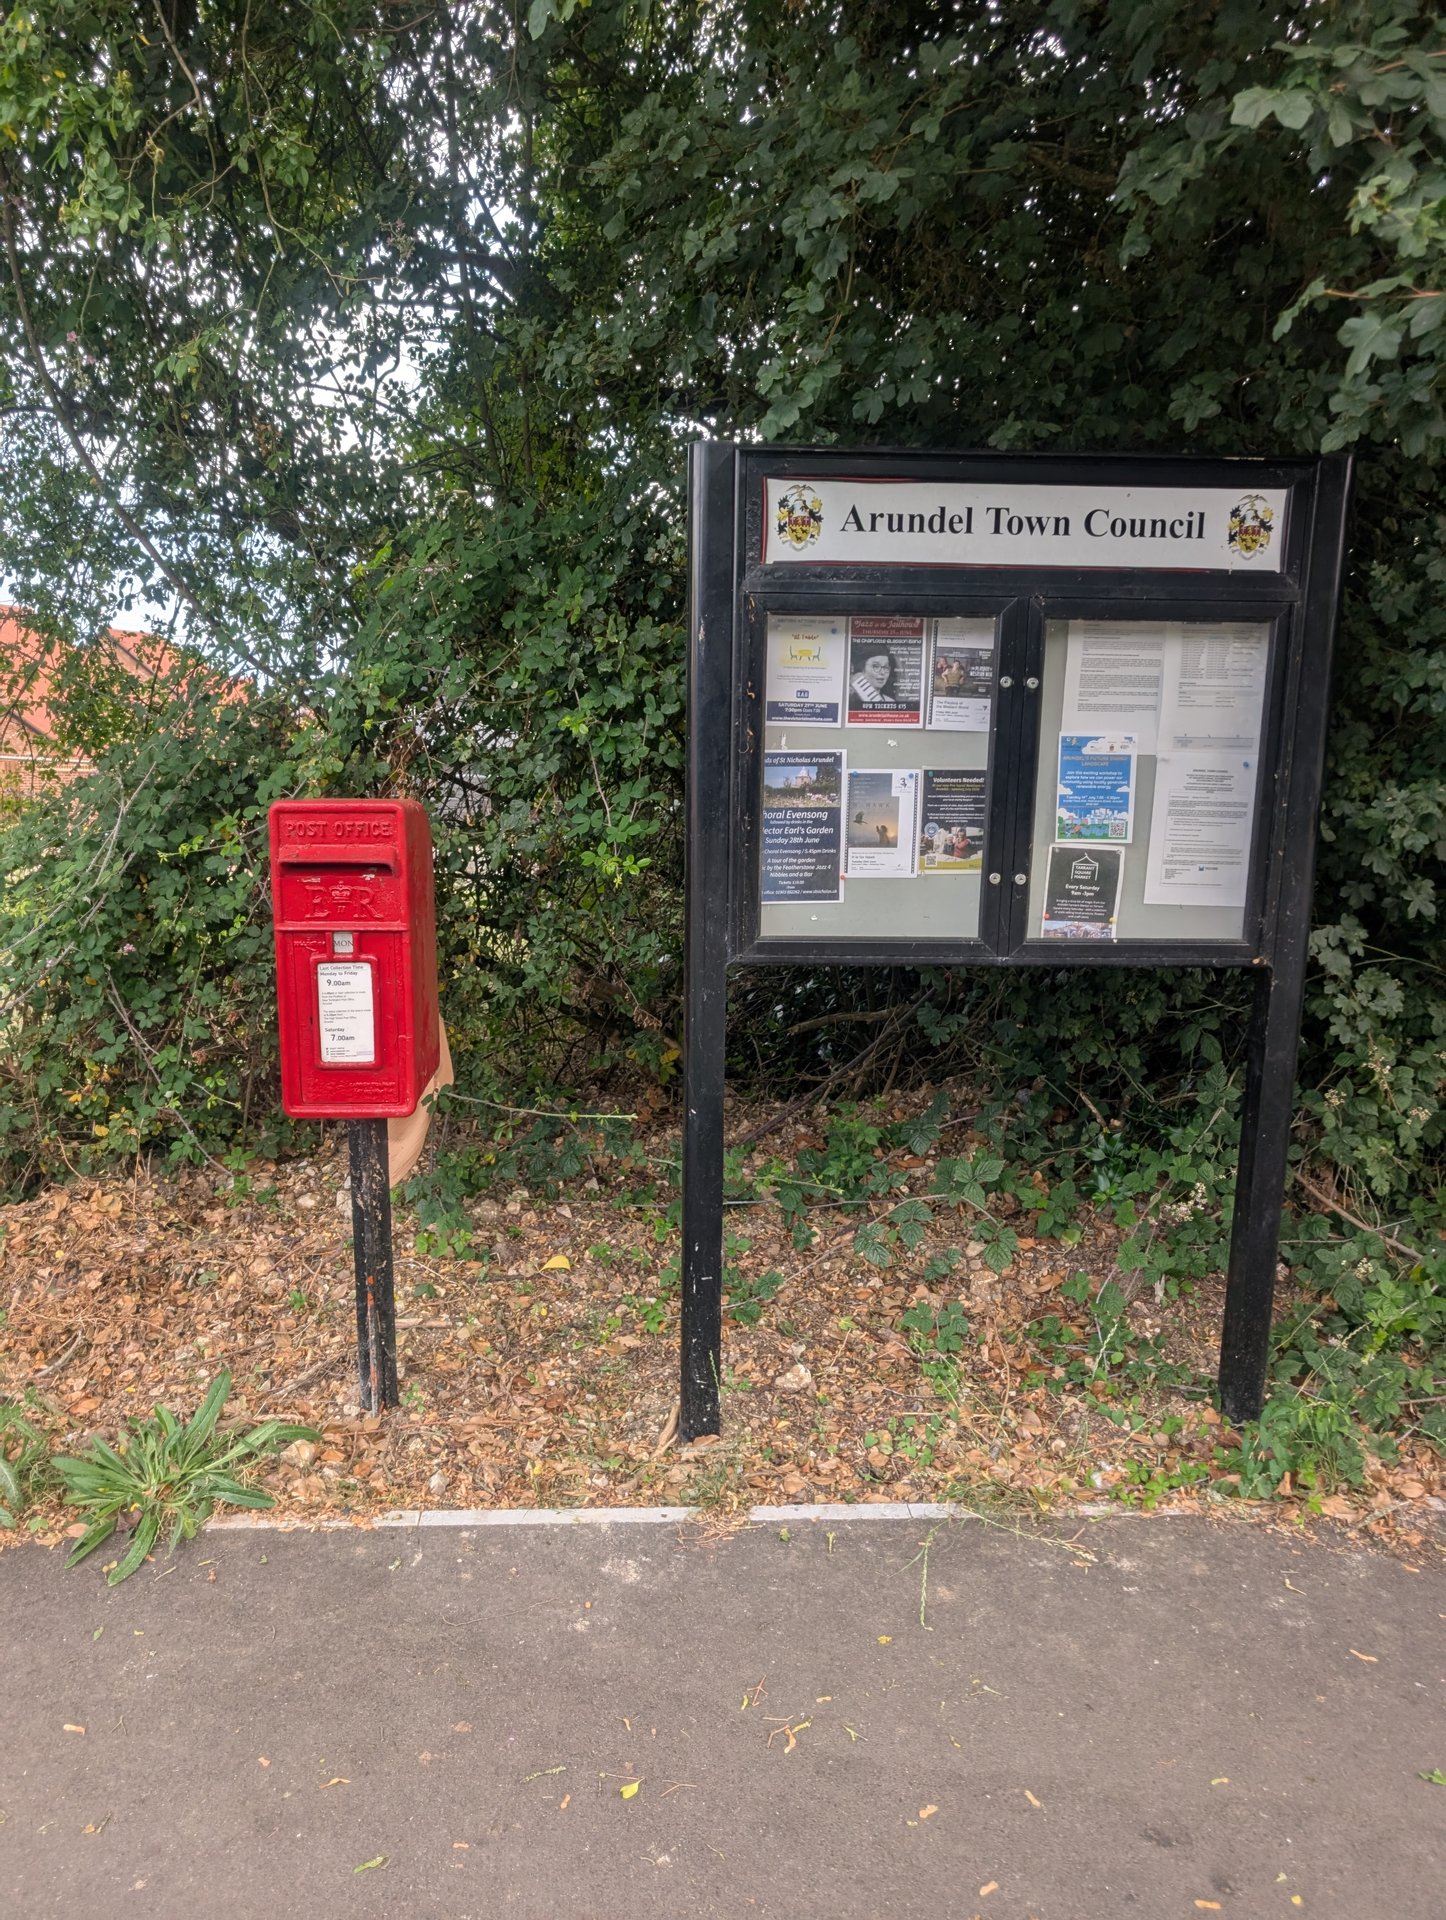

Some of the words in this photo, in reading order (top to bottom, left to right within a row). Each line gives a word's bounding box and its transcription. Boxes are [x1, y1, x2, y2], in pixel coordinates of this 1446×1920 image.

[840, 504, 974, 535] Arundel
[986, 507, 1071, 536] Town
[1084, 509, 1205, 539] Council
[854, 620, 873, 628] Jazz
[763, 810, 785, 819] horal
[786, 810, 828, 820] Evensong
[285, 820, 327, 838] POST
[335, 820, 393, 838] OFFICE
[784, 827, 805, 835] Earl's
[806, 827, 834, 835] Garden
[765, 837, 789, 845] Sunday
[352, 885, 384, 918] R
[326, 979, 351, 987] 9.00am
